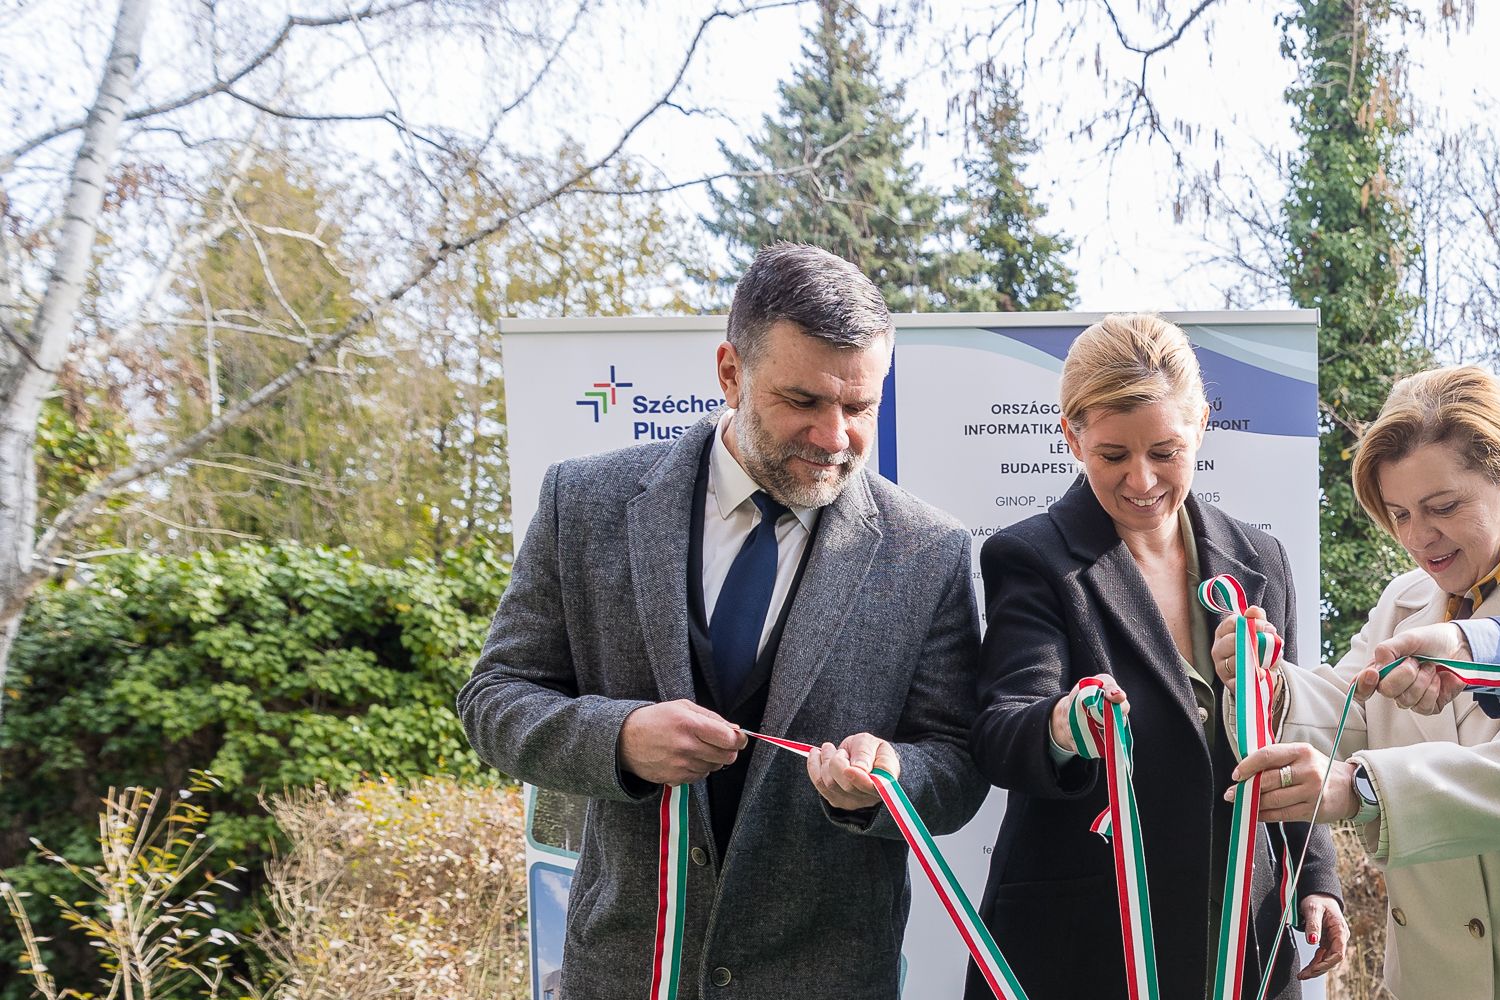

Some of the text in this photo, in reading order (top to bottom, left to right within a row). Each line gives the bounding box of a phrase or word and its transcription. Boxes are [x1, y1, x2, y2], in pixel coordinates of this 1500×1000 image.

[990, 400, 1061, 415] ORSZÁGO
[633, 421, 692, 441] Plus
[963, 421, 1064, 436] INFORMATIKA
